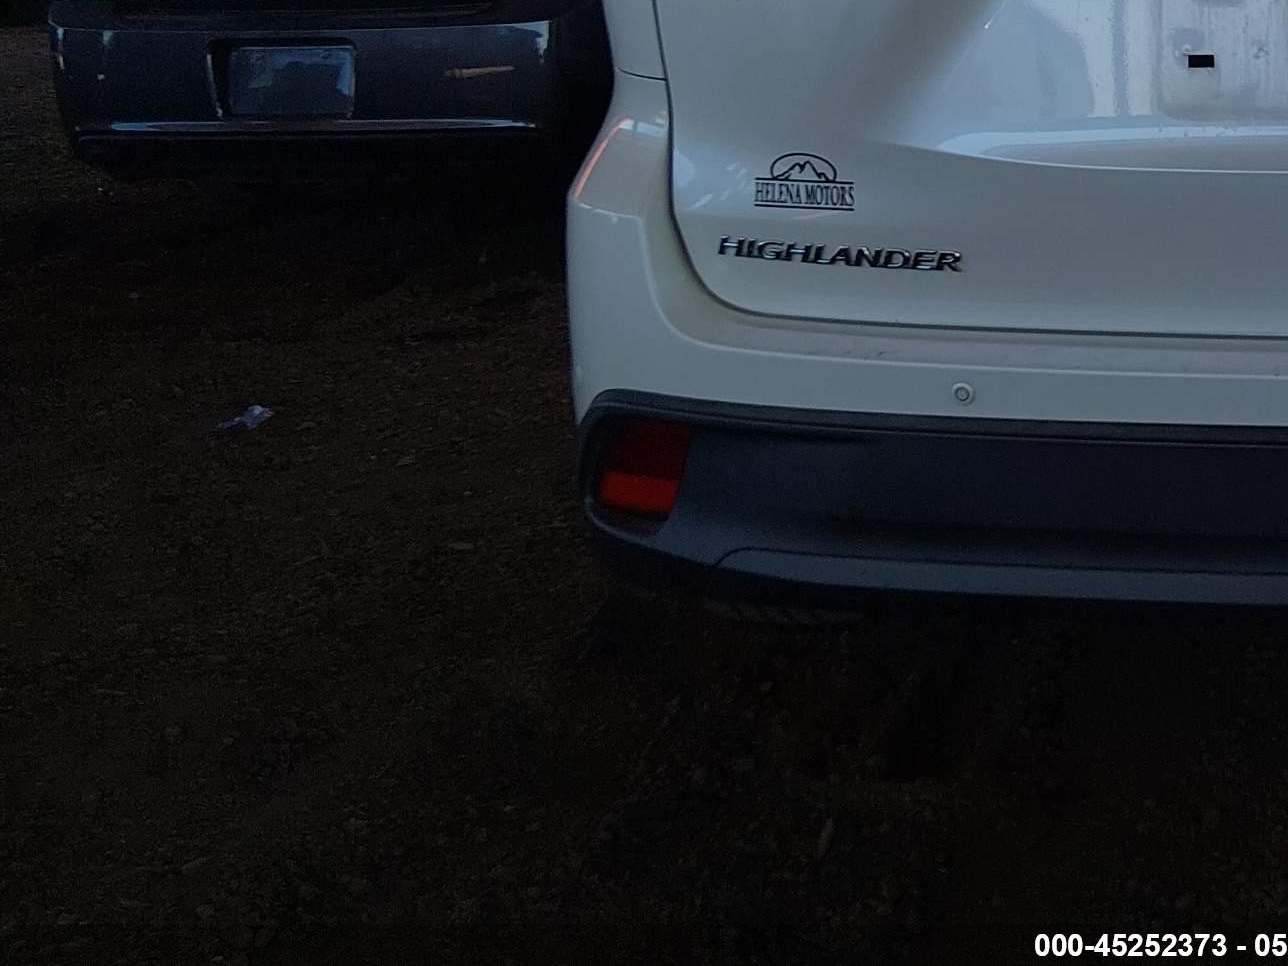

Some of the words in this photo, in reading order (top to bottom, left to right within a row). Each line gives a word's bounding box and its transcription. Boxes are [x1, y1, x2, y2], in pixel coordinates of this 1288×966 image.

[754, 182, 802, 204] HELENA
[804, 184, 855, 207] MOTORS
[718, 235, 962, 272] HIGHLANDER
